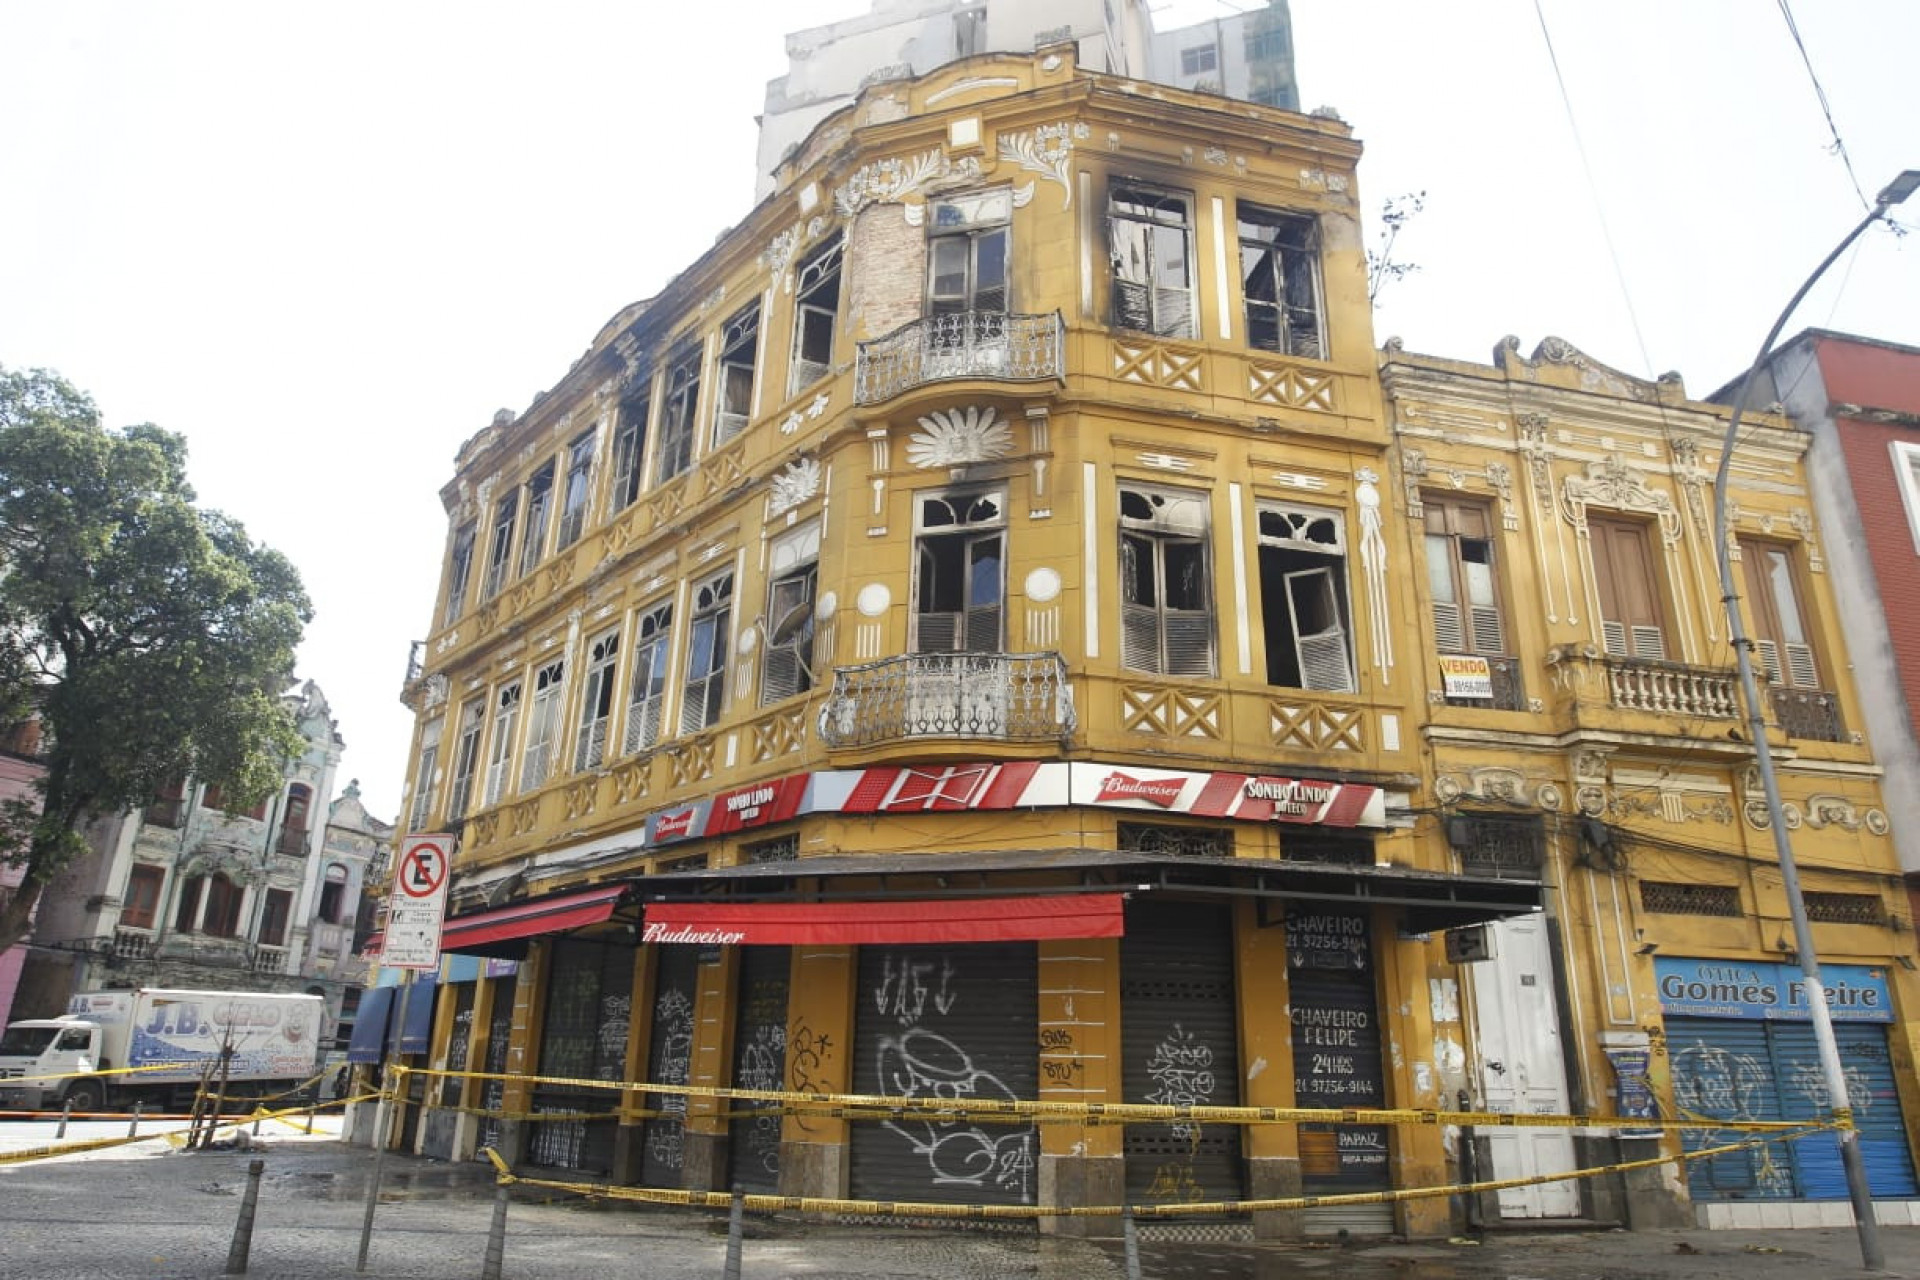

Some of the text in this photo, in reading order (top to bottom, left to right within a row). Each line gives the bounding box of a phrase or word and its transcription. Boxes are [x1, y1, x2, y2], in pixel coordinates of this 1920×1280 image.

[1102, 777, 1181, 796] Budweiser
[1248, 782, 1332, 804] SONHO LINDO
[642, 922, 745, 944] Budweiser
[1661, 974, 1878, 1006] Gomes Feire
[1291, 1007, 1367, 1029] CHAVEIRO
[1304, 1027, 1358, 1047] FELIPE
[1339, 1131, 1379, 1147] PAPAIZ
